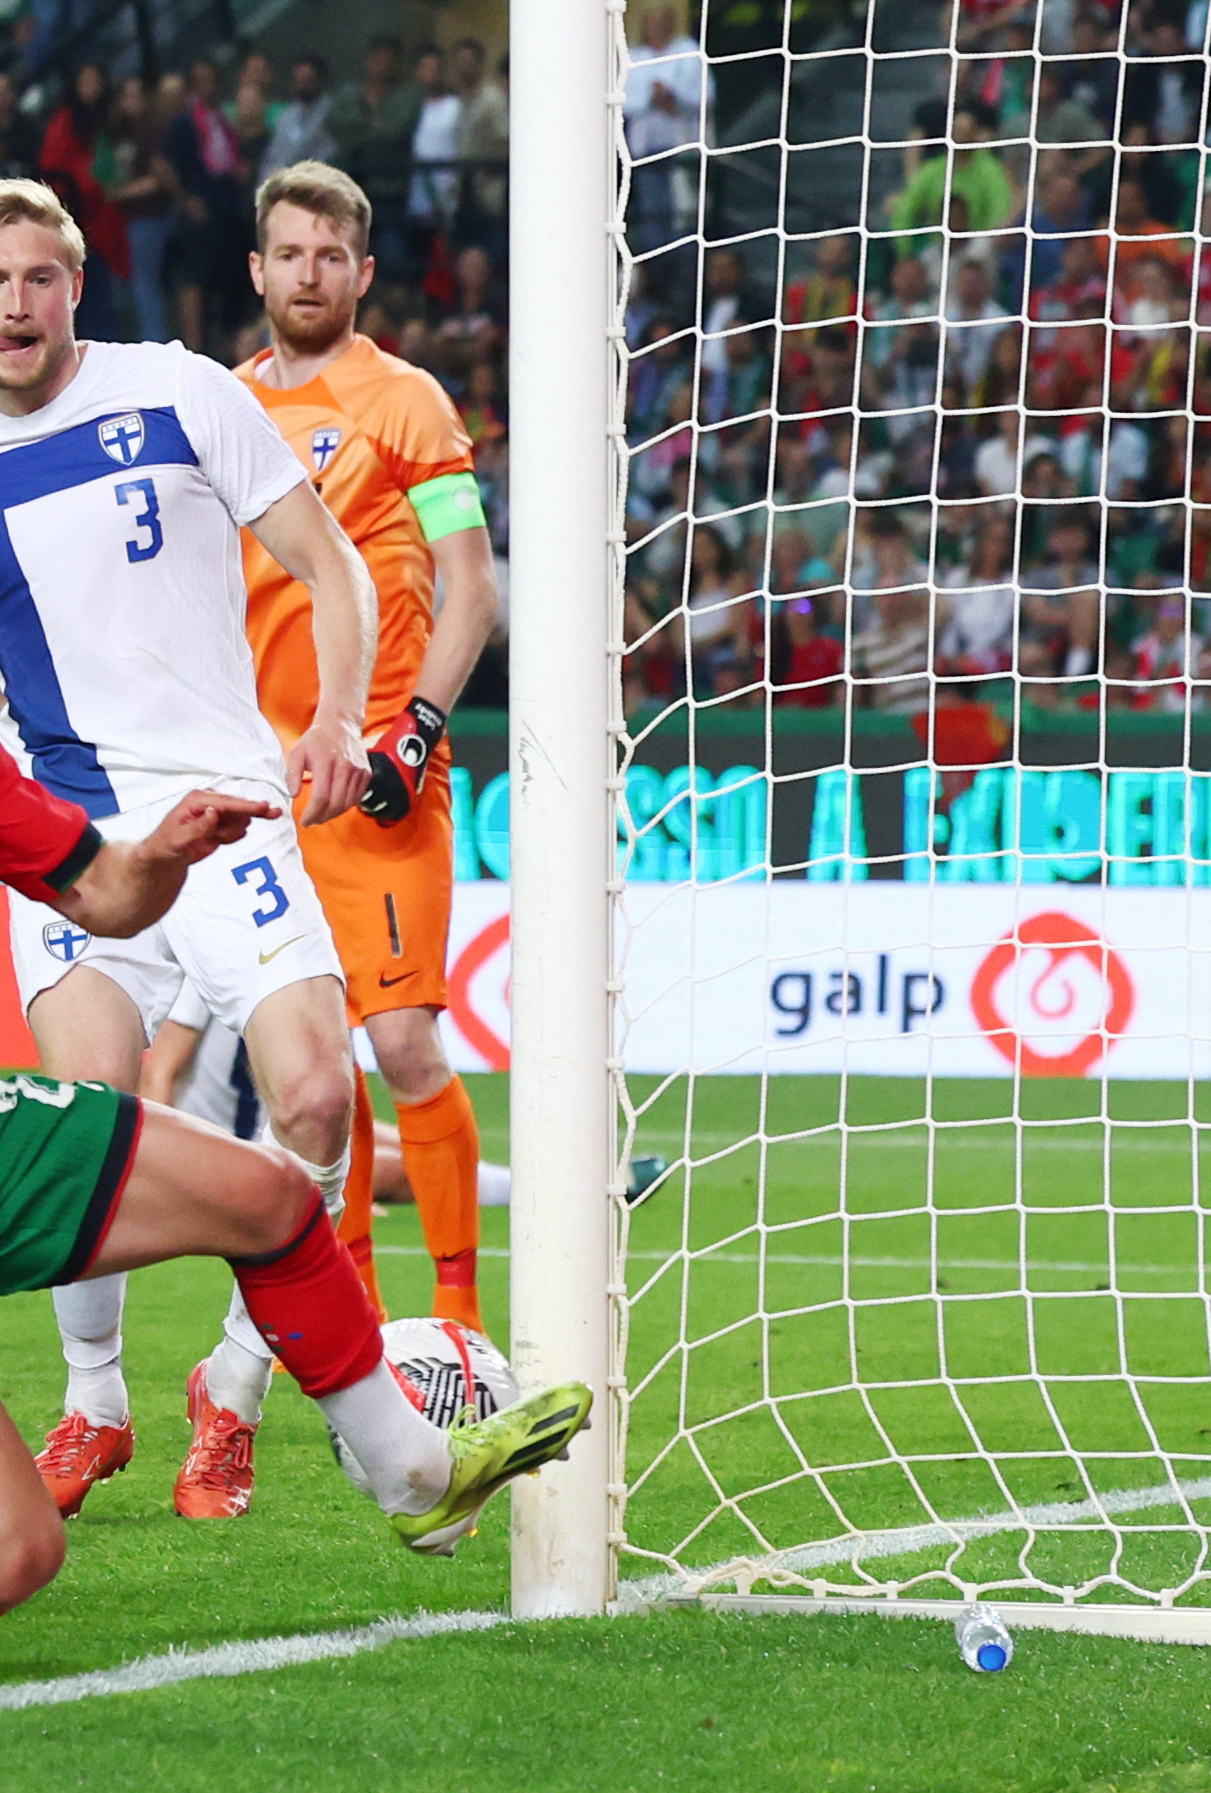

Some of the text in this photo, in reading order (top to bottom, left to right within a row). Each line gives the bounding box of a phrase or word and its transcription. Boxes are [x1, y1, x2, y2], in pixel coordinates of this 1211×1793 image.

[117, 478, 165, 563] 3
[230, 856, 290, 928] 3
[771, 954, 945, 1037] galp
